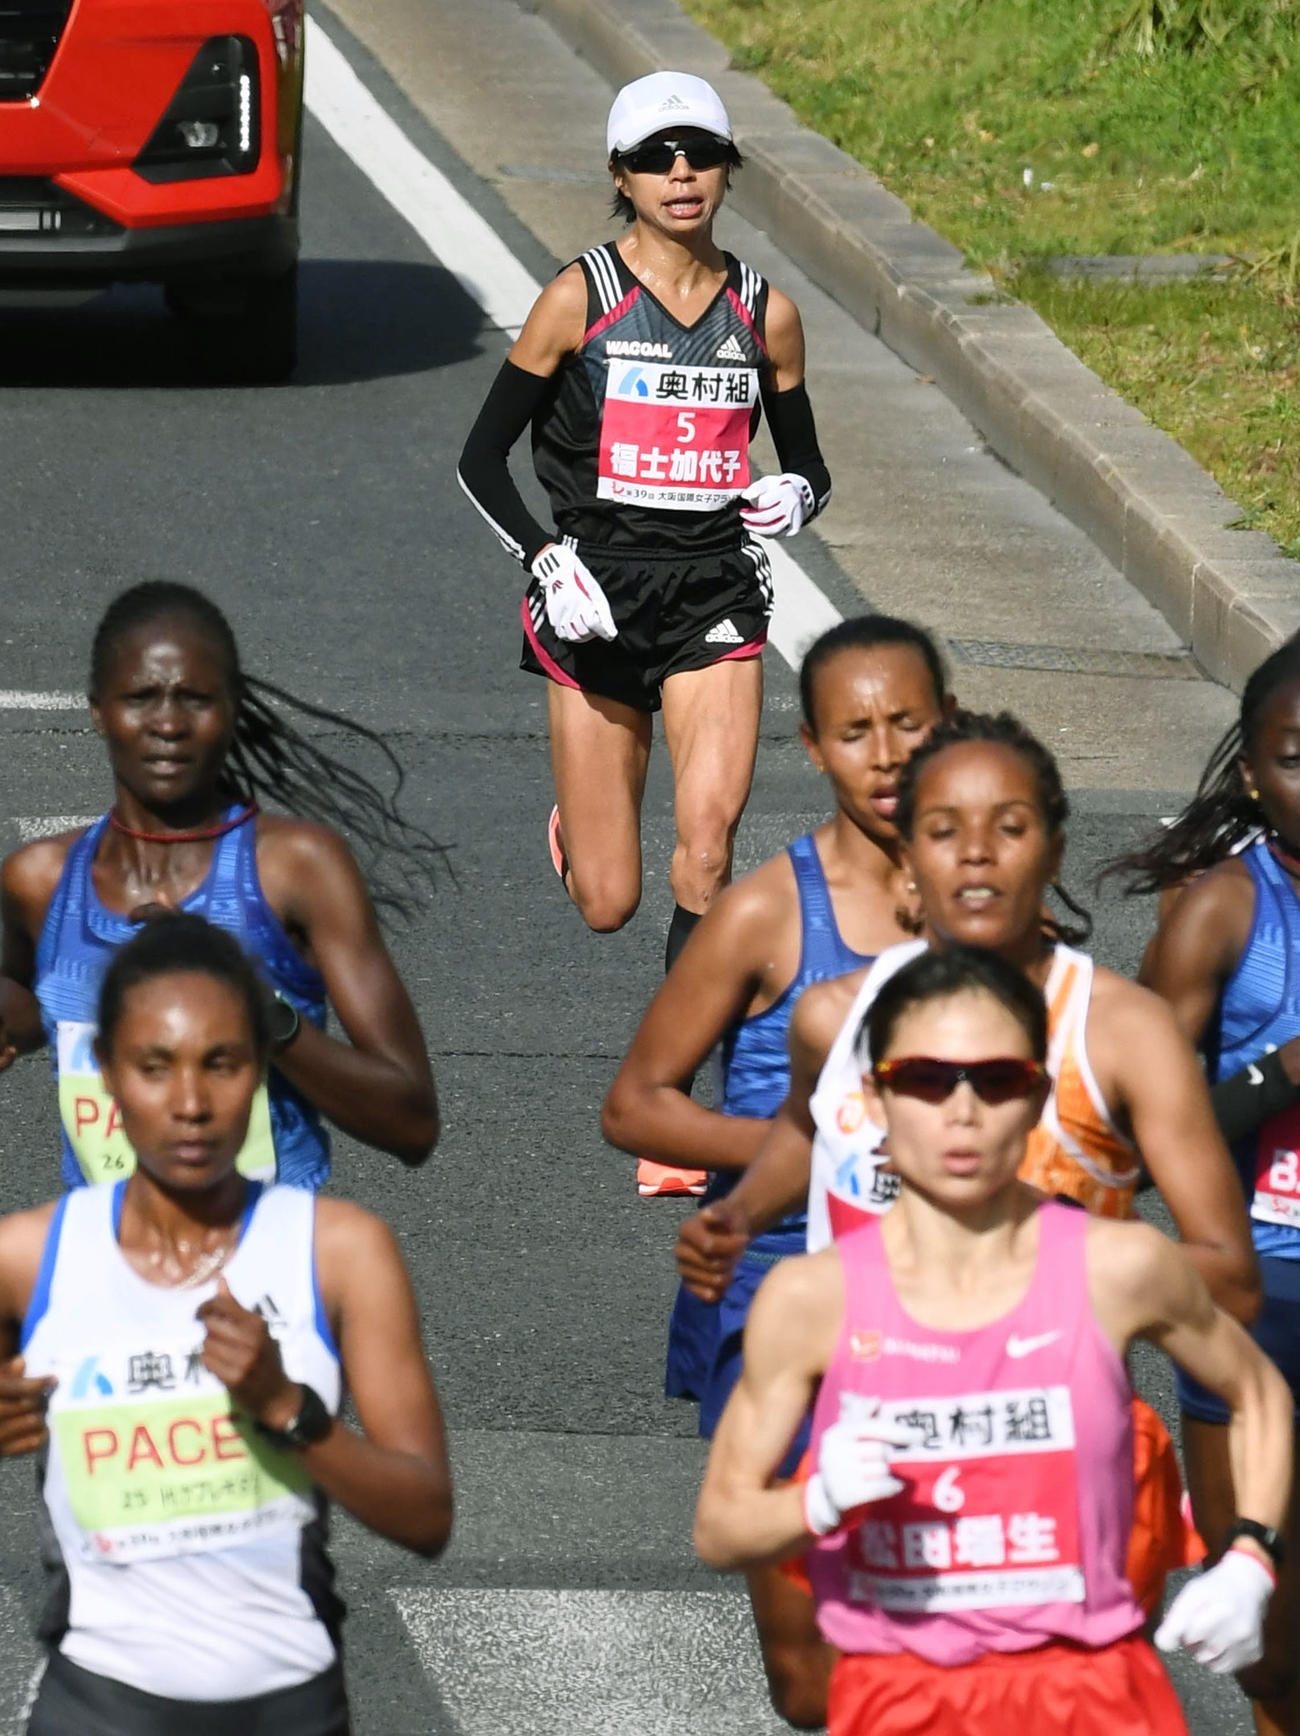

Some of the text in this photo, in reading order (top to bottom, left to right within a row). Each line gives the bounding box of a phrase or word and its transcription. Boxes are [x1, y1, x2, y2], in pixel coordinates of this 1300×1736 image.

[605, 340, 673, 358] WACOAL
[716, 349, 747, 362] adidas
[656, 370, 750, 403] 奥村組
[676, 412, 696, 443] 5
[610, 442, 741, 483] 福士加代子
[74, 1096, 127, 1138] PA
[102, 1154, 125, 1170] 26
[82, 1413, 248, 1477] PACE
[931, 1465, 966, 1514] 6
